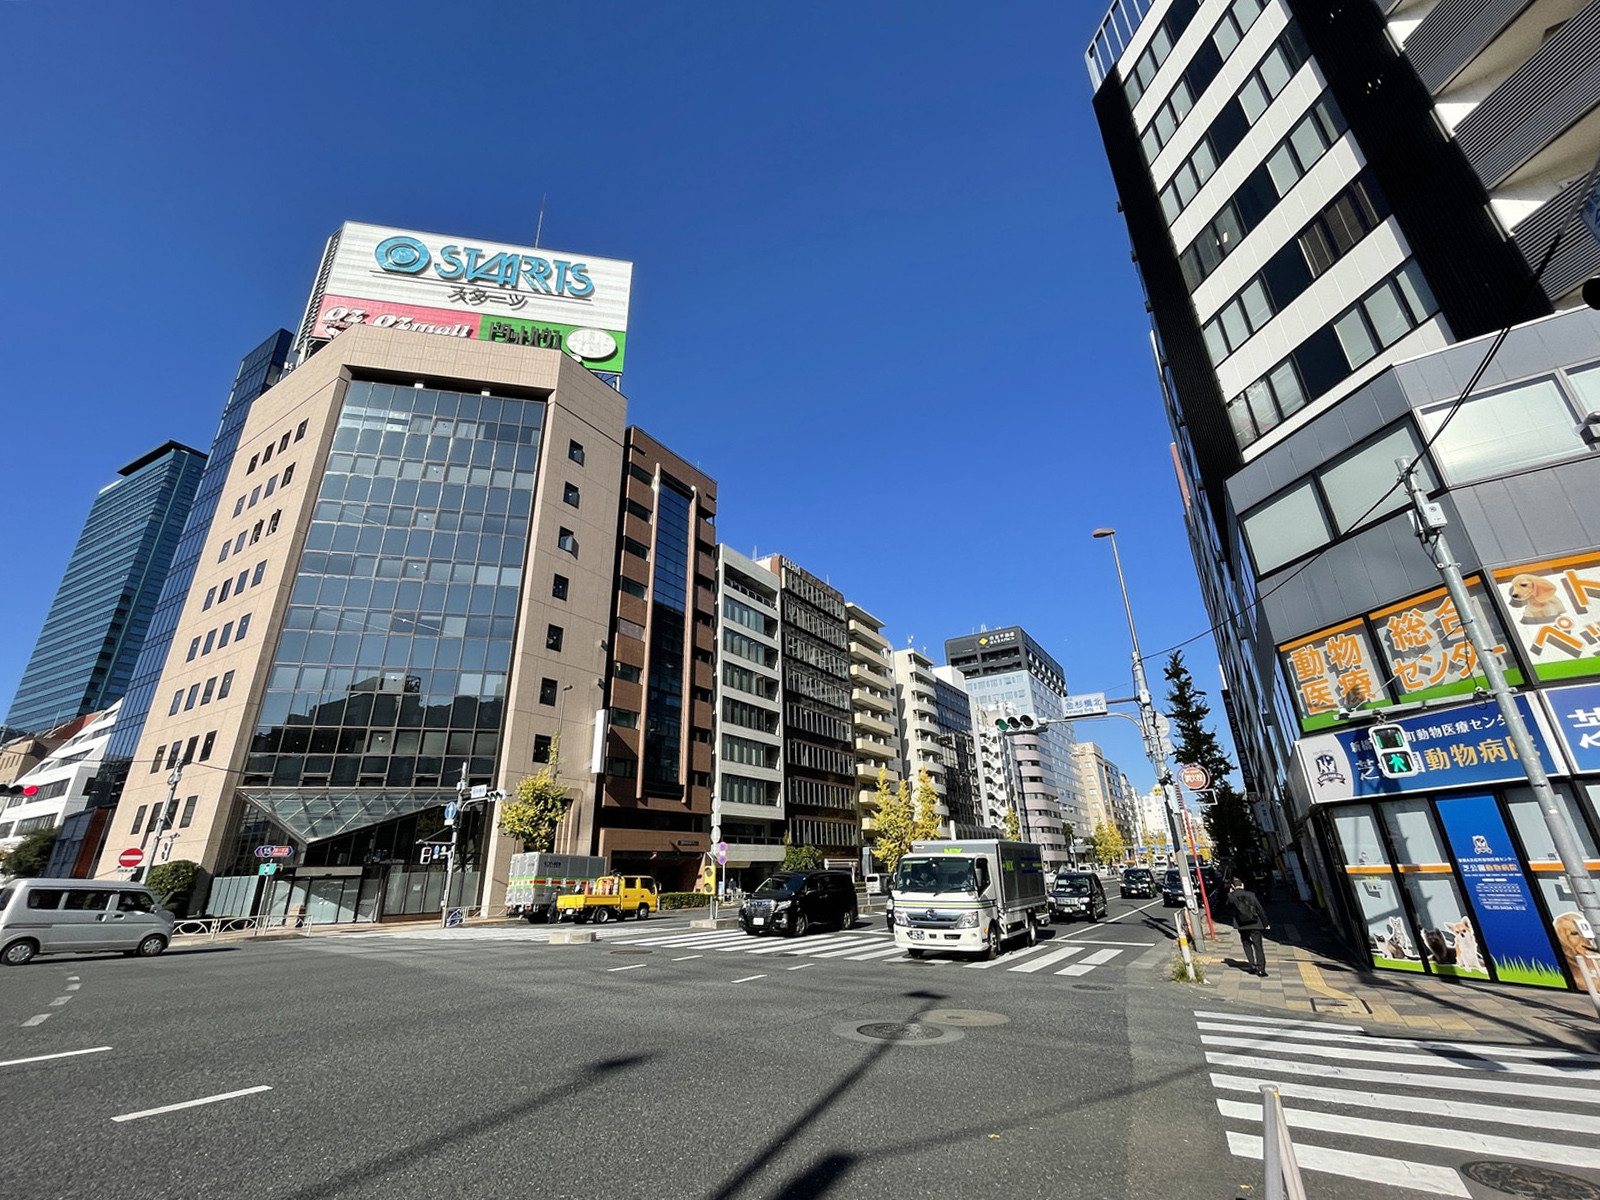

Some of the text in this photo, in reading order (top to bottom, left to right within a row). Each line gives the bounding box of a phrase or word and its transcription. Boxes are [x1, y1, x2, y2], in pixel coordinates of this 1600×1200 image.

[448, 286, 528, 310] スターツ
[1291, 634, 1362, 680] 動物
[1302, 668, 1376, 714] 医療
